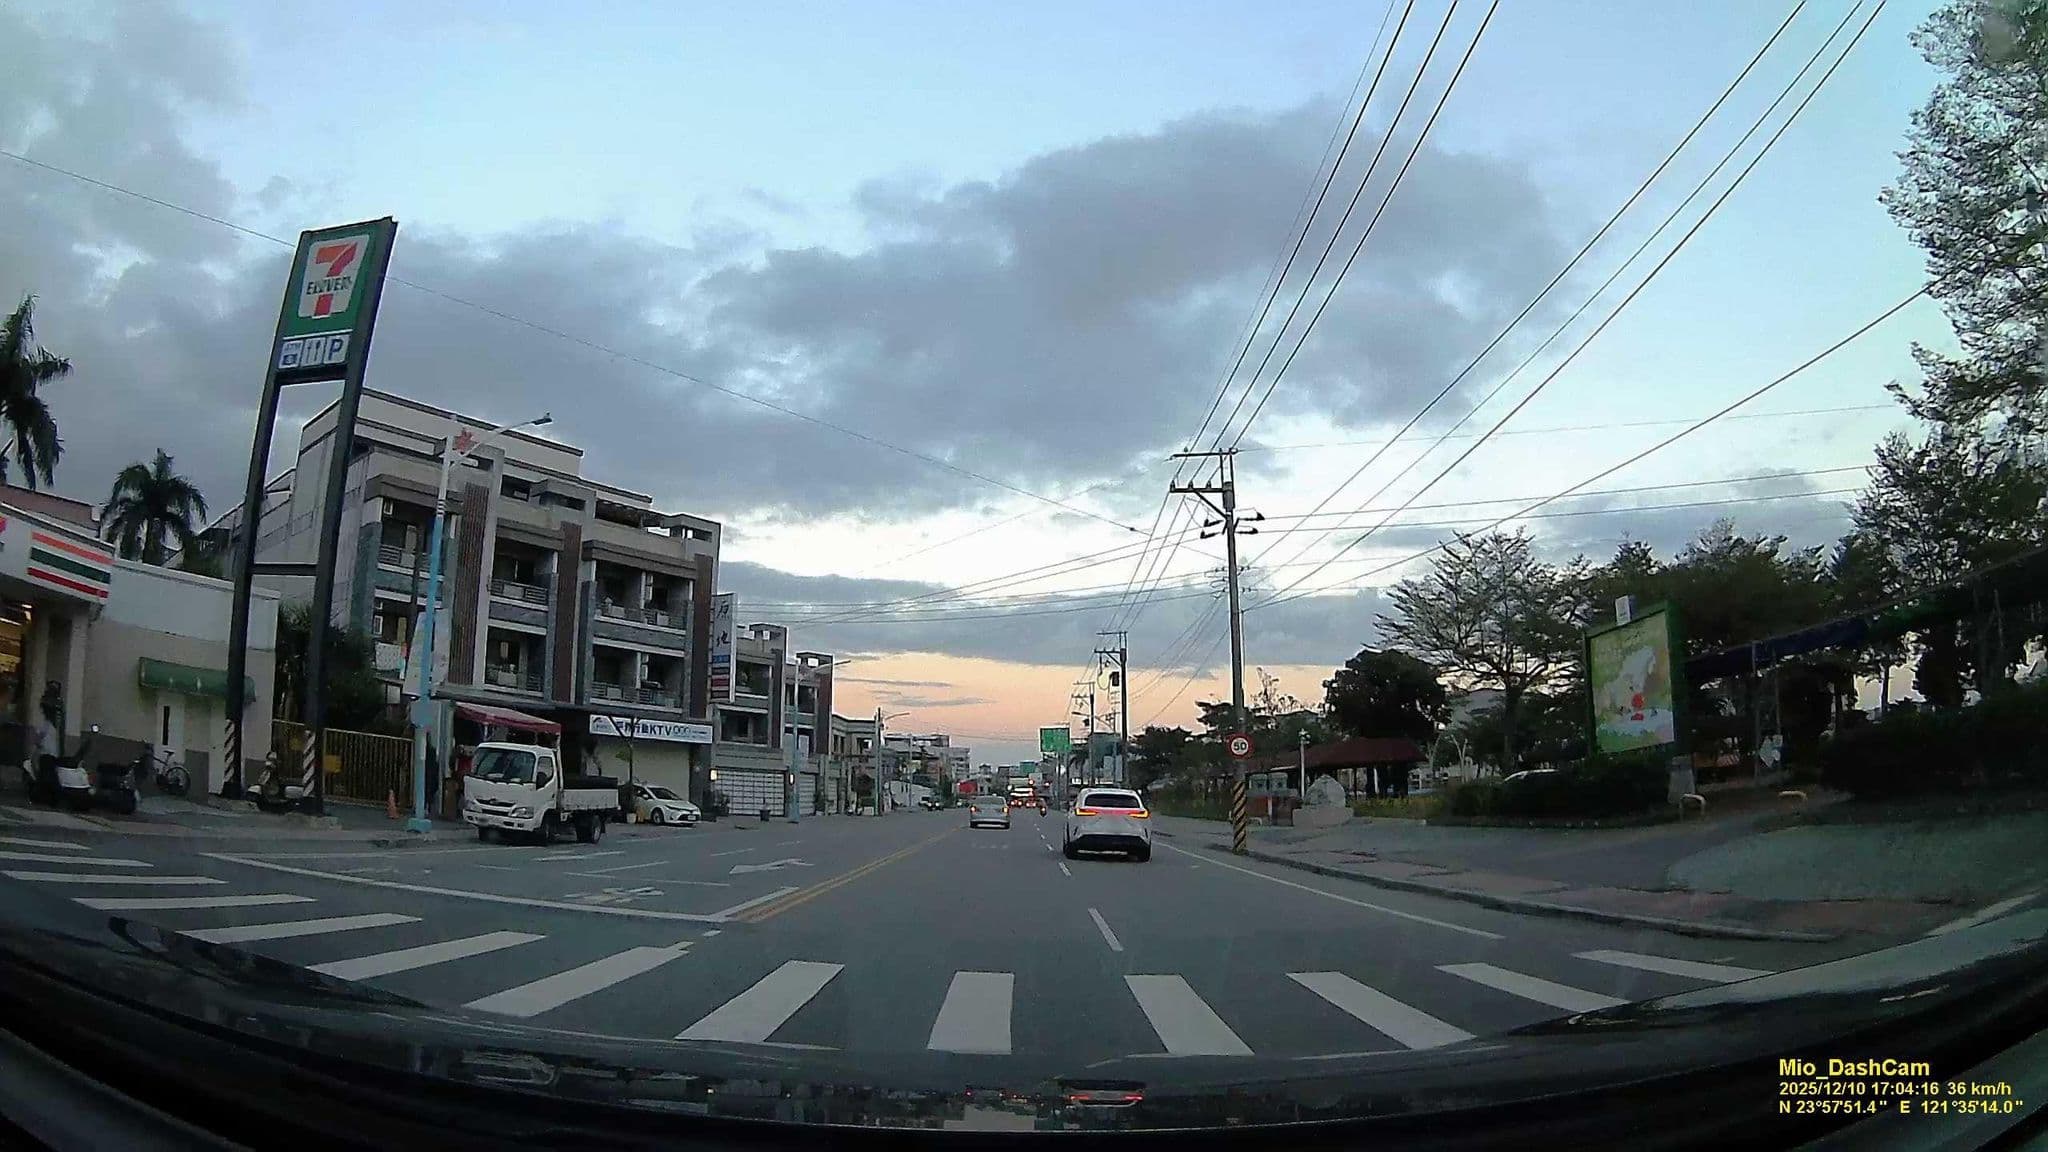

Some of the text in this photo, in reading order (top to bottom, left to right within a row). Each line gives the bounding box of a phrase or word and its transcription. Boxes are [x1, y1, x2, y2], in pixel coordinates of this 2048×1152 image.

[315, 243, 358, 316] 7
[328, 338, 344, 361] P
[1233, 741, 1247, 751] 50
